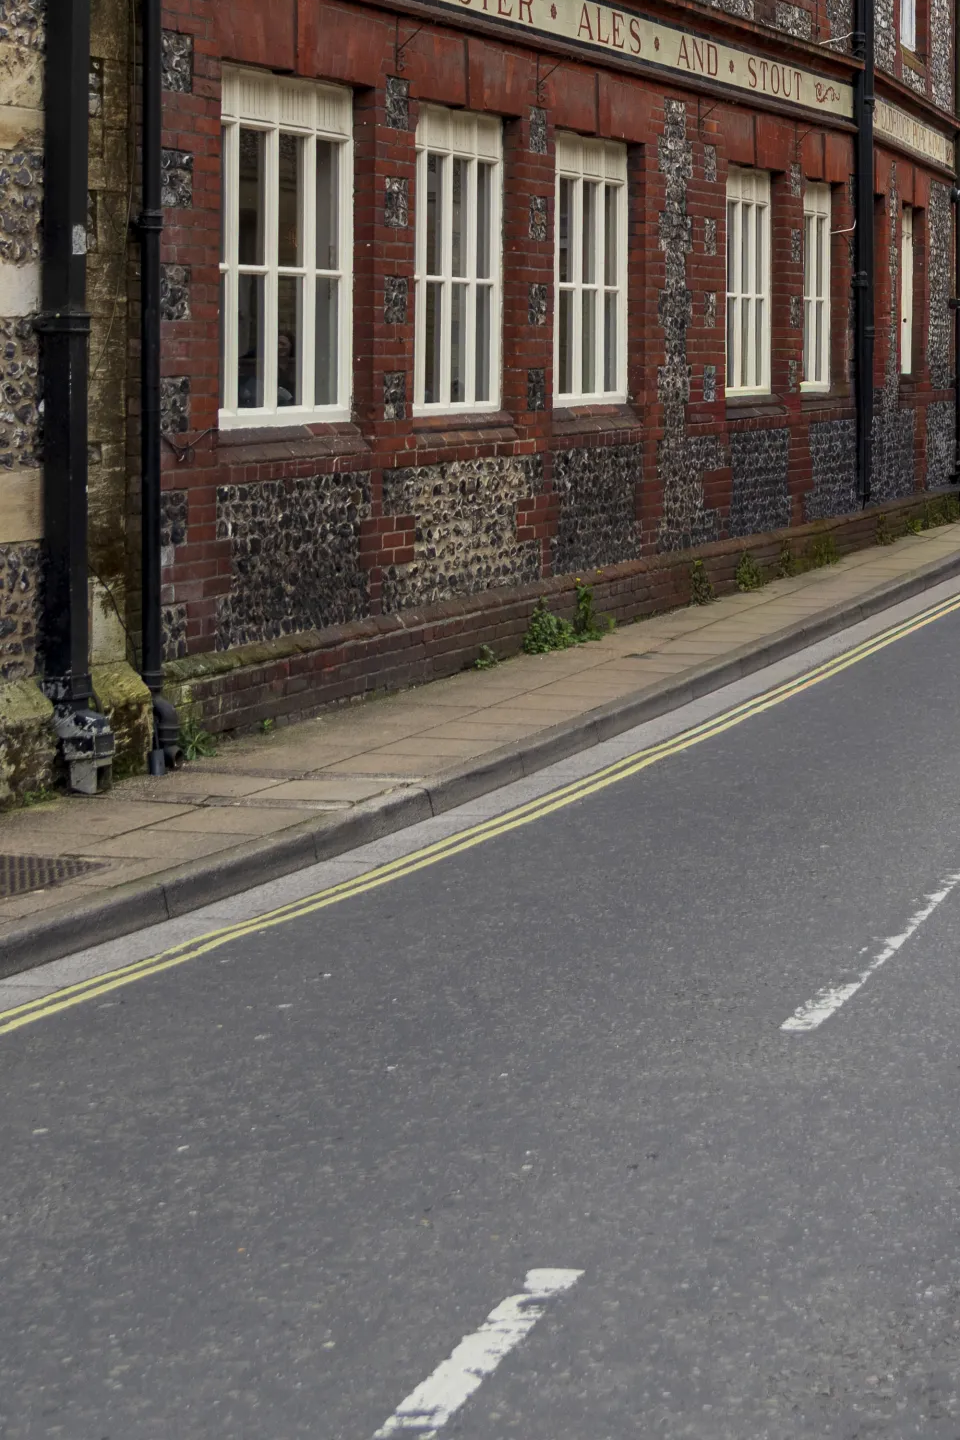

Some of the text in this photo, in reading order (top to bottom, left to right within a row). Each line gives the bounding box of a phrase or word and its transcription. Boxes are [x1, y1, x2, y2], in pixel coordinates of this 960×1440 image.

[577, 2, 642, 55] ALES
[676, 35, 719, 77] AND
[747, 57, 803, 101] STOUT
